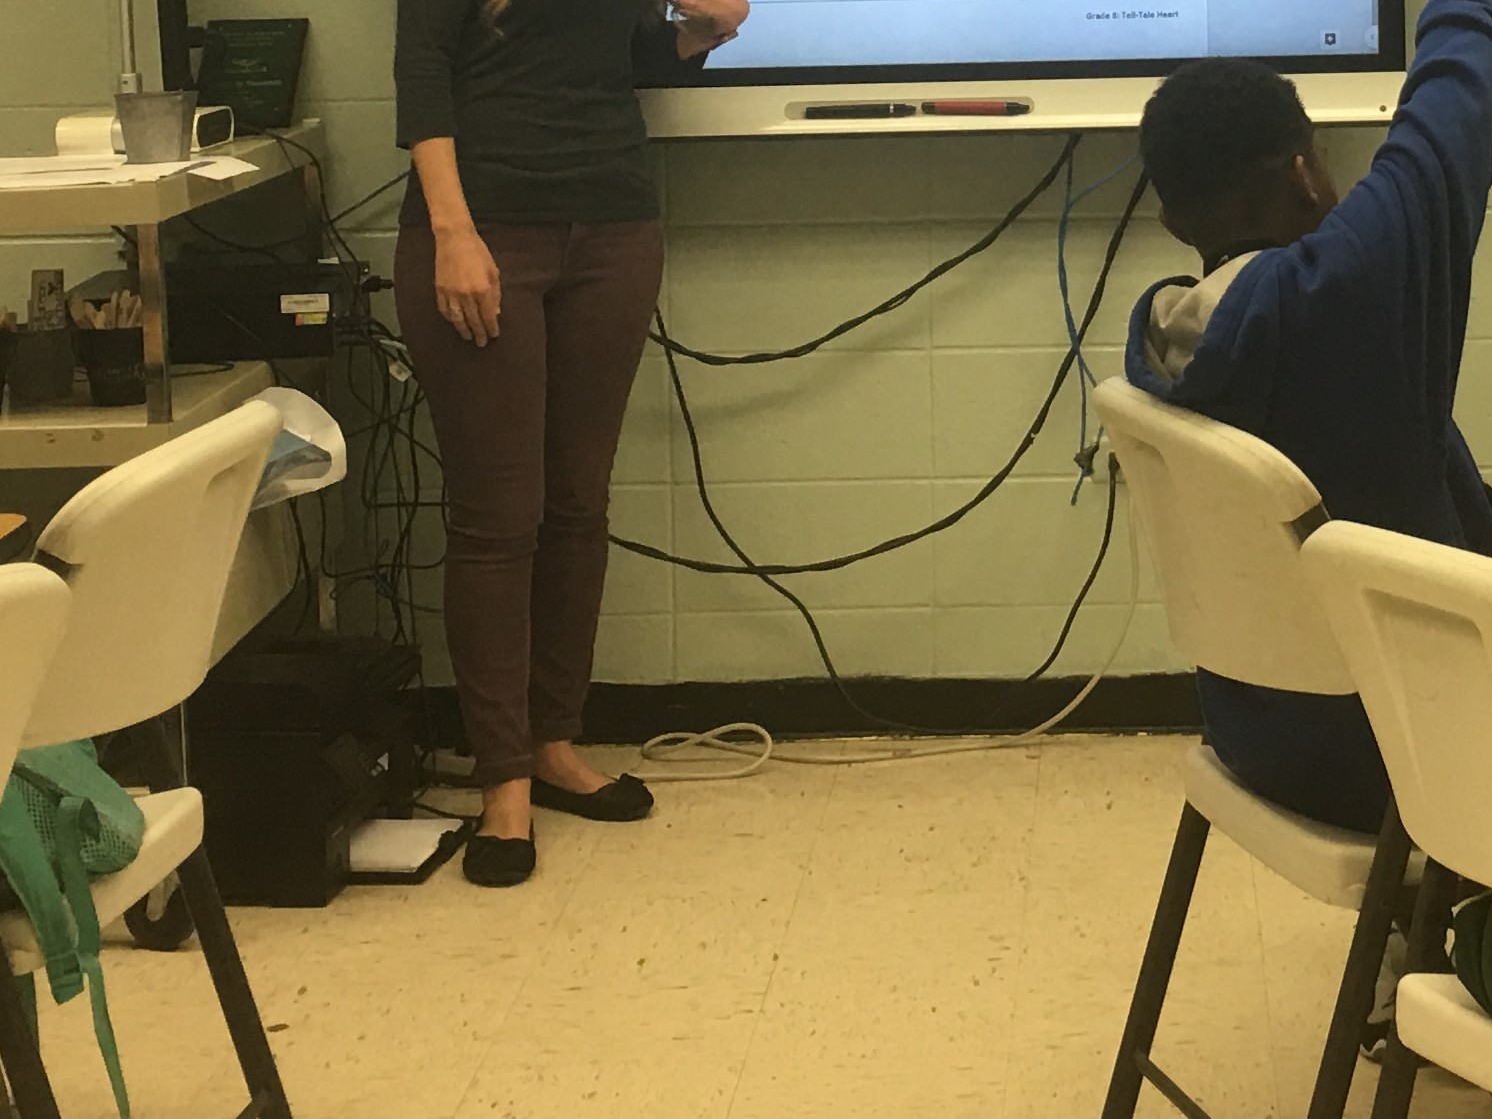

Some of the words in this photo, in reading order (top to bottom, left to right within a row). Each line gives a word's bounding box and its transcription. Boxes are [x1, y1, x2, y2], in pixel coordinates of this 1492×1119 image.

[1086, 12, 1110, 20] Grade
[1121, 11, 1155, 20] Tell-Tale
[1157, 11, 1179, 19] Heart
